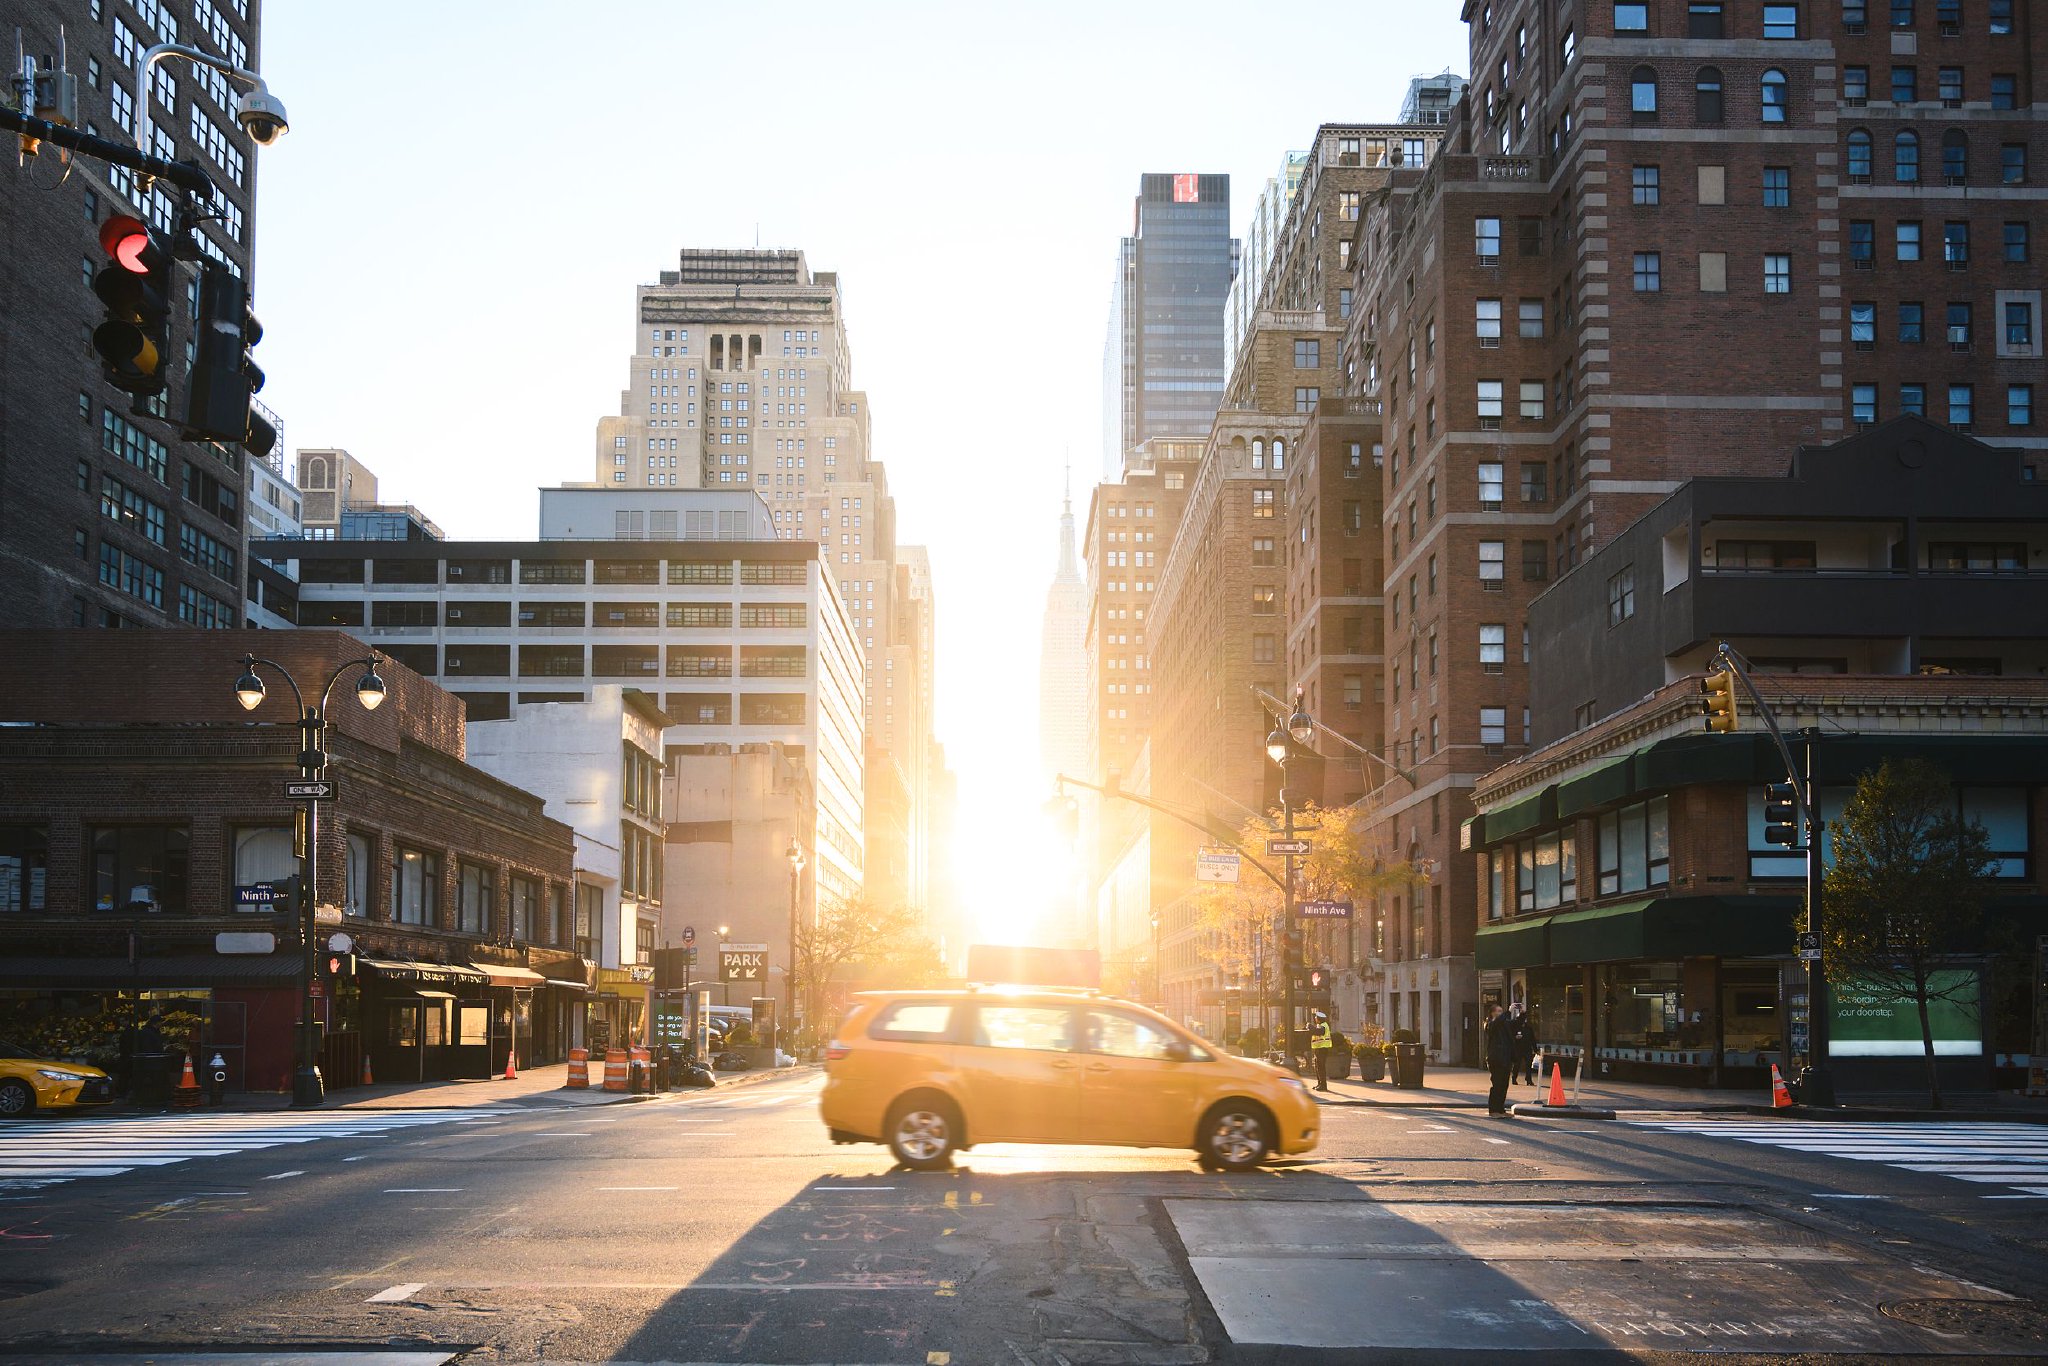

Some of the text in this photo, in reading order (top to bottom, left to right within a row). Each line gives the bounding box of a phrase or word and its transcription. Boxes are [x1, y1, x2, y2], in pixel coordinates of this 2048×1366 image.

[241, 890, 270, 900] Ninth
[1304, 905, 1346, 915] Ninth Ave
[724, 953, 762, 966] PARK
[1664, 992, 1677, 1000] SAVE
[1837, 1008, 1895, 1018] your doorstep.
